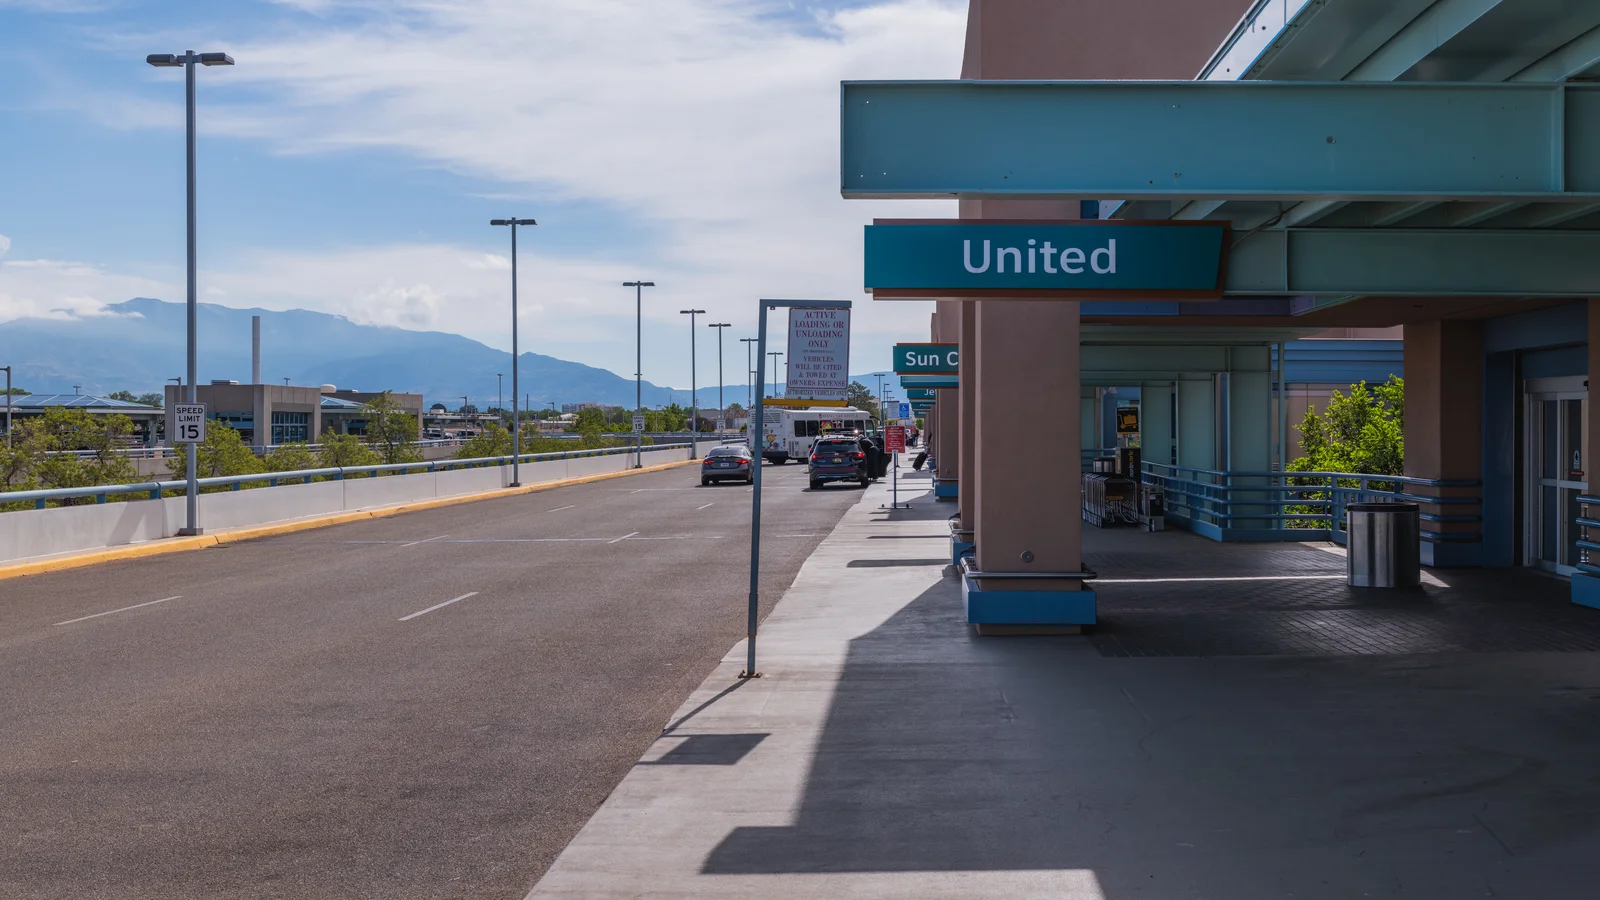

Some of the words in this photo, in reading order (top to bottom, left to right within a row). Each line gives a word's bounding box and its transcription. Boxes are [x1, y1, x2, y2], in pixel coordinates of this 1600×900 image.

[964, 238, 1116, 274] United
[906, 352, 939, 366] Sun
[180, 425, 199, 439] 15
